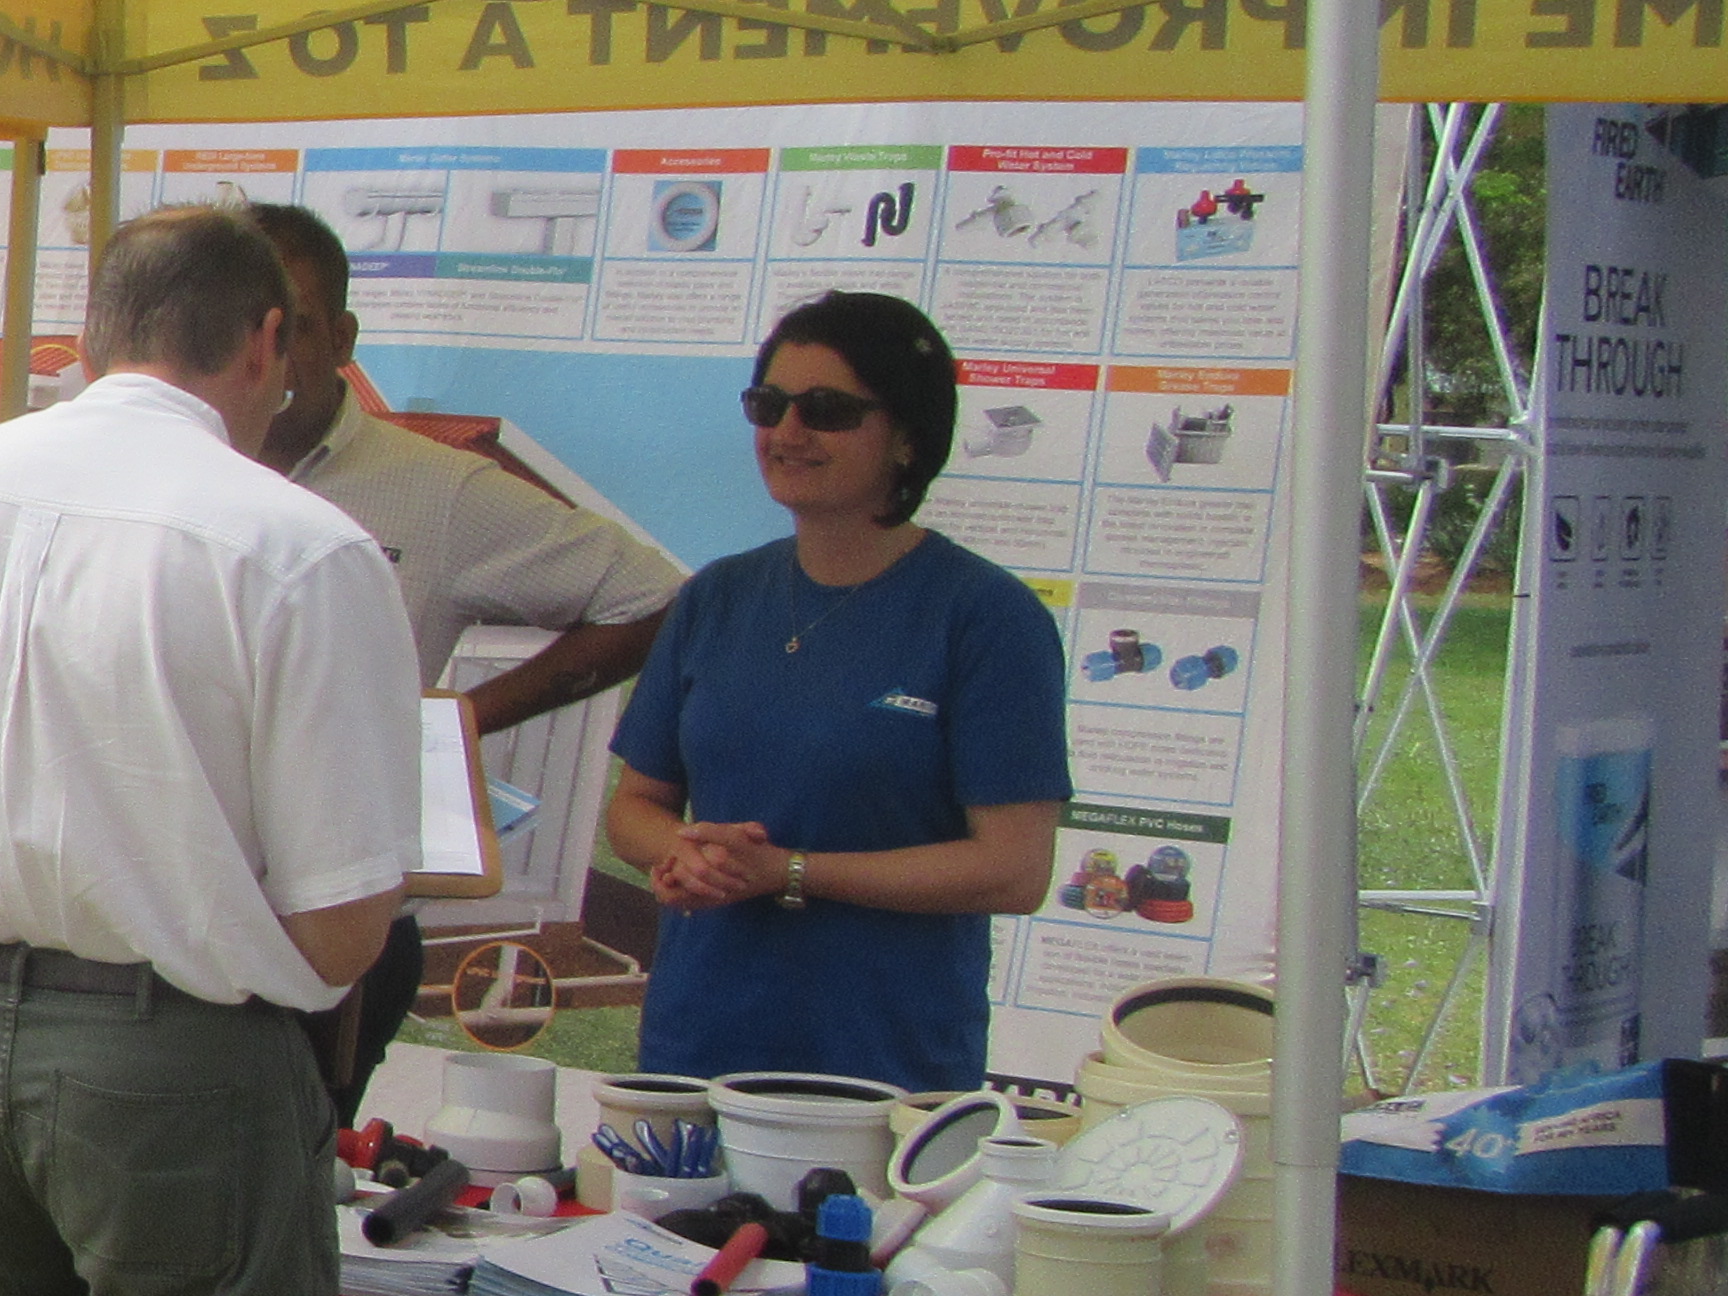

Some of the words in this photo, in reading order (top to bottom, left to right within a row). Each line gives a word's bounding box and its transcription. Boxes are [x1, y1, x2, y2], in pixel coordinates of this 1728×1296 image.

[1594, 116, 1639, 160] FIRED
[660, 156, 722, 166] Accessories
[998, 160, 1031, 171] Water
[1033, 160, 1075, 172] System
[1614, 161, 1666, 202] EARTH
[1583, 264, 1668, 327] BREAK
[1002, 363, 1056, 375] Universal
[1555, 333, 1685, 398] THROUGH
[968, 372, 1012, 384] Shower
[1015, 374, 1046, 386] Traps
[1071, 809, 1137, 827] MEGAFLEX
[1139, 814, 1164, 829] PVC
[1167, 818, 1204, 832] Hoses
